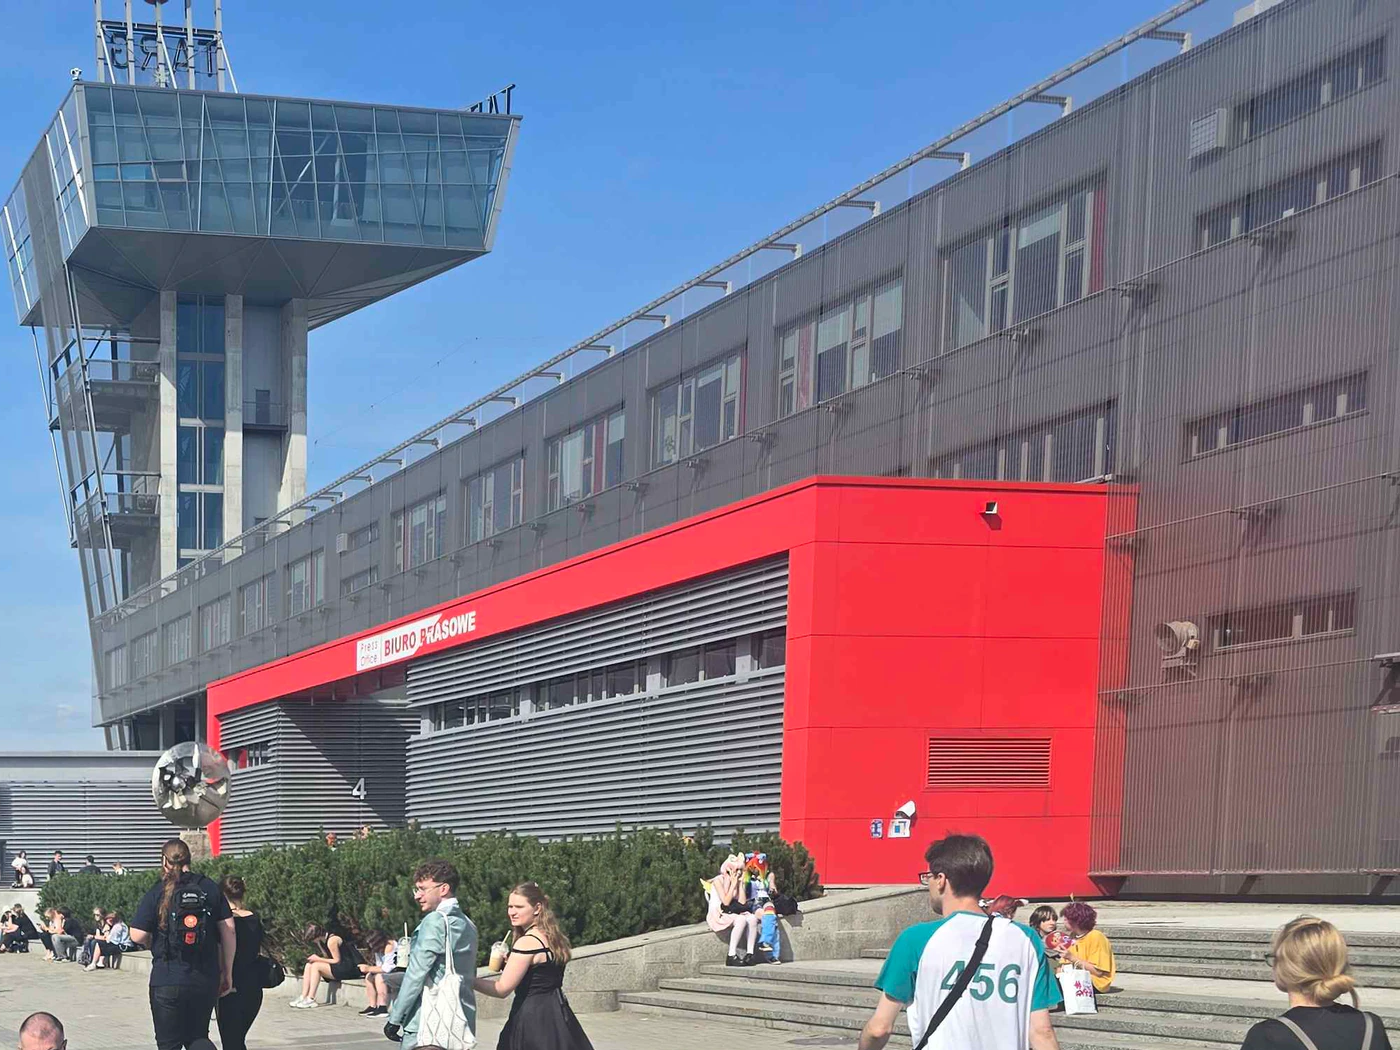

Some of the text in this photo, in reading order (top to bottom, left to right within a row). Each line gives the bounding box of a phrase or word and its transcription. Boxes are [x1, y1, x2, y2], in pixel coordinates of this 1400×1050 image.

[384, 610, 477, 657] BIURO PRASOWE
[352, 777, 367, 800] 4
[940, 960, 1022, 1004] 456
